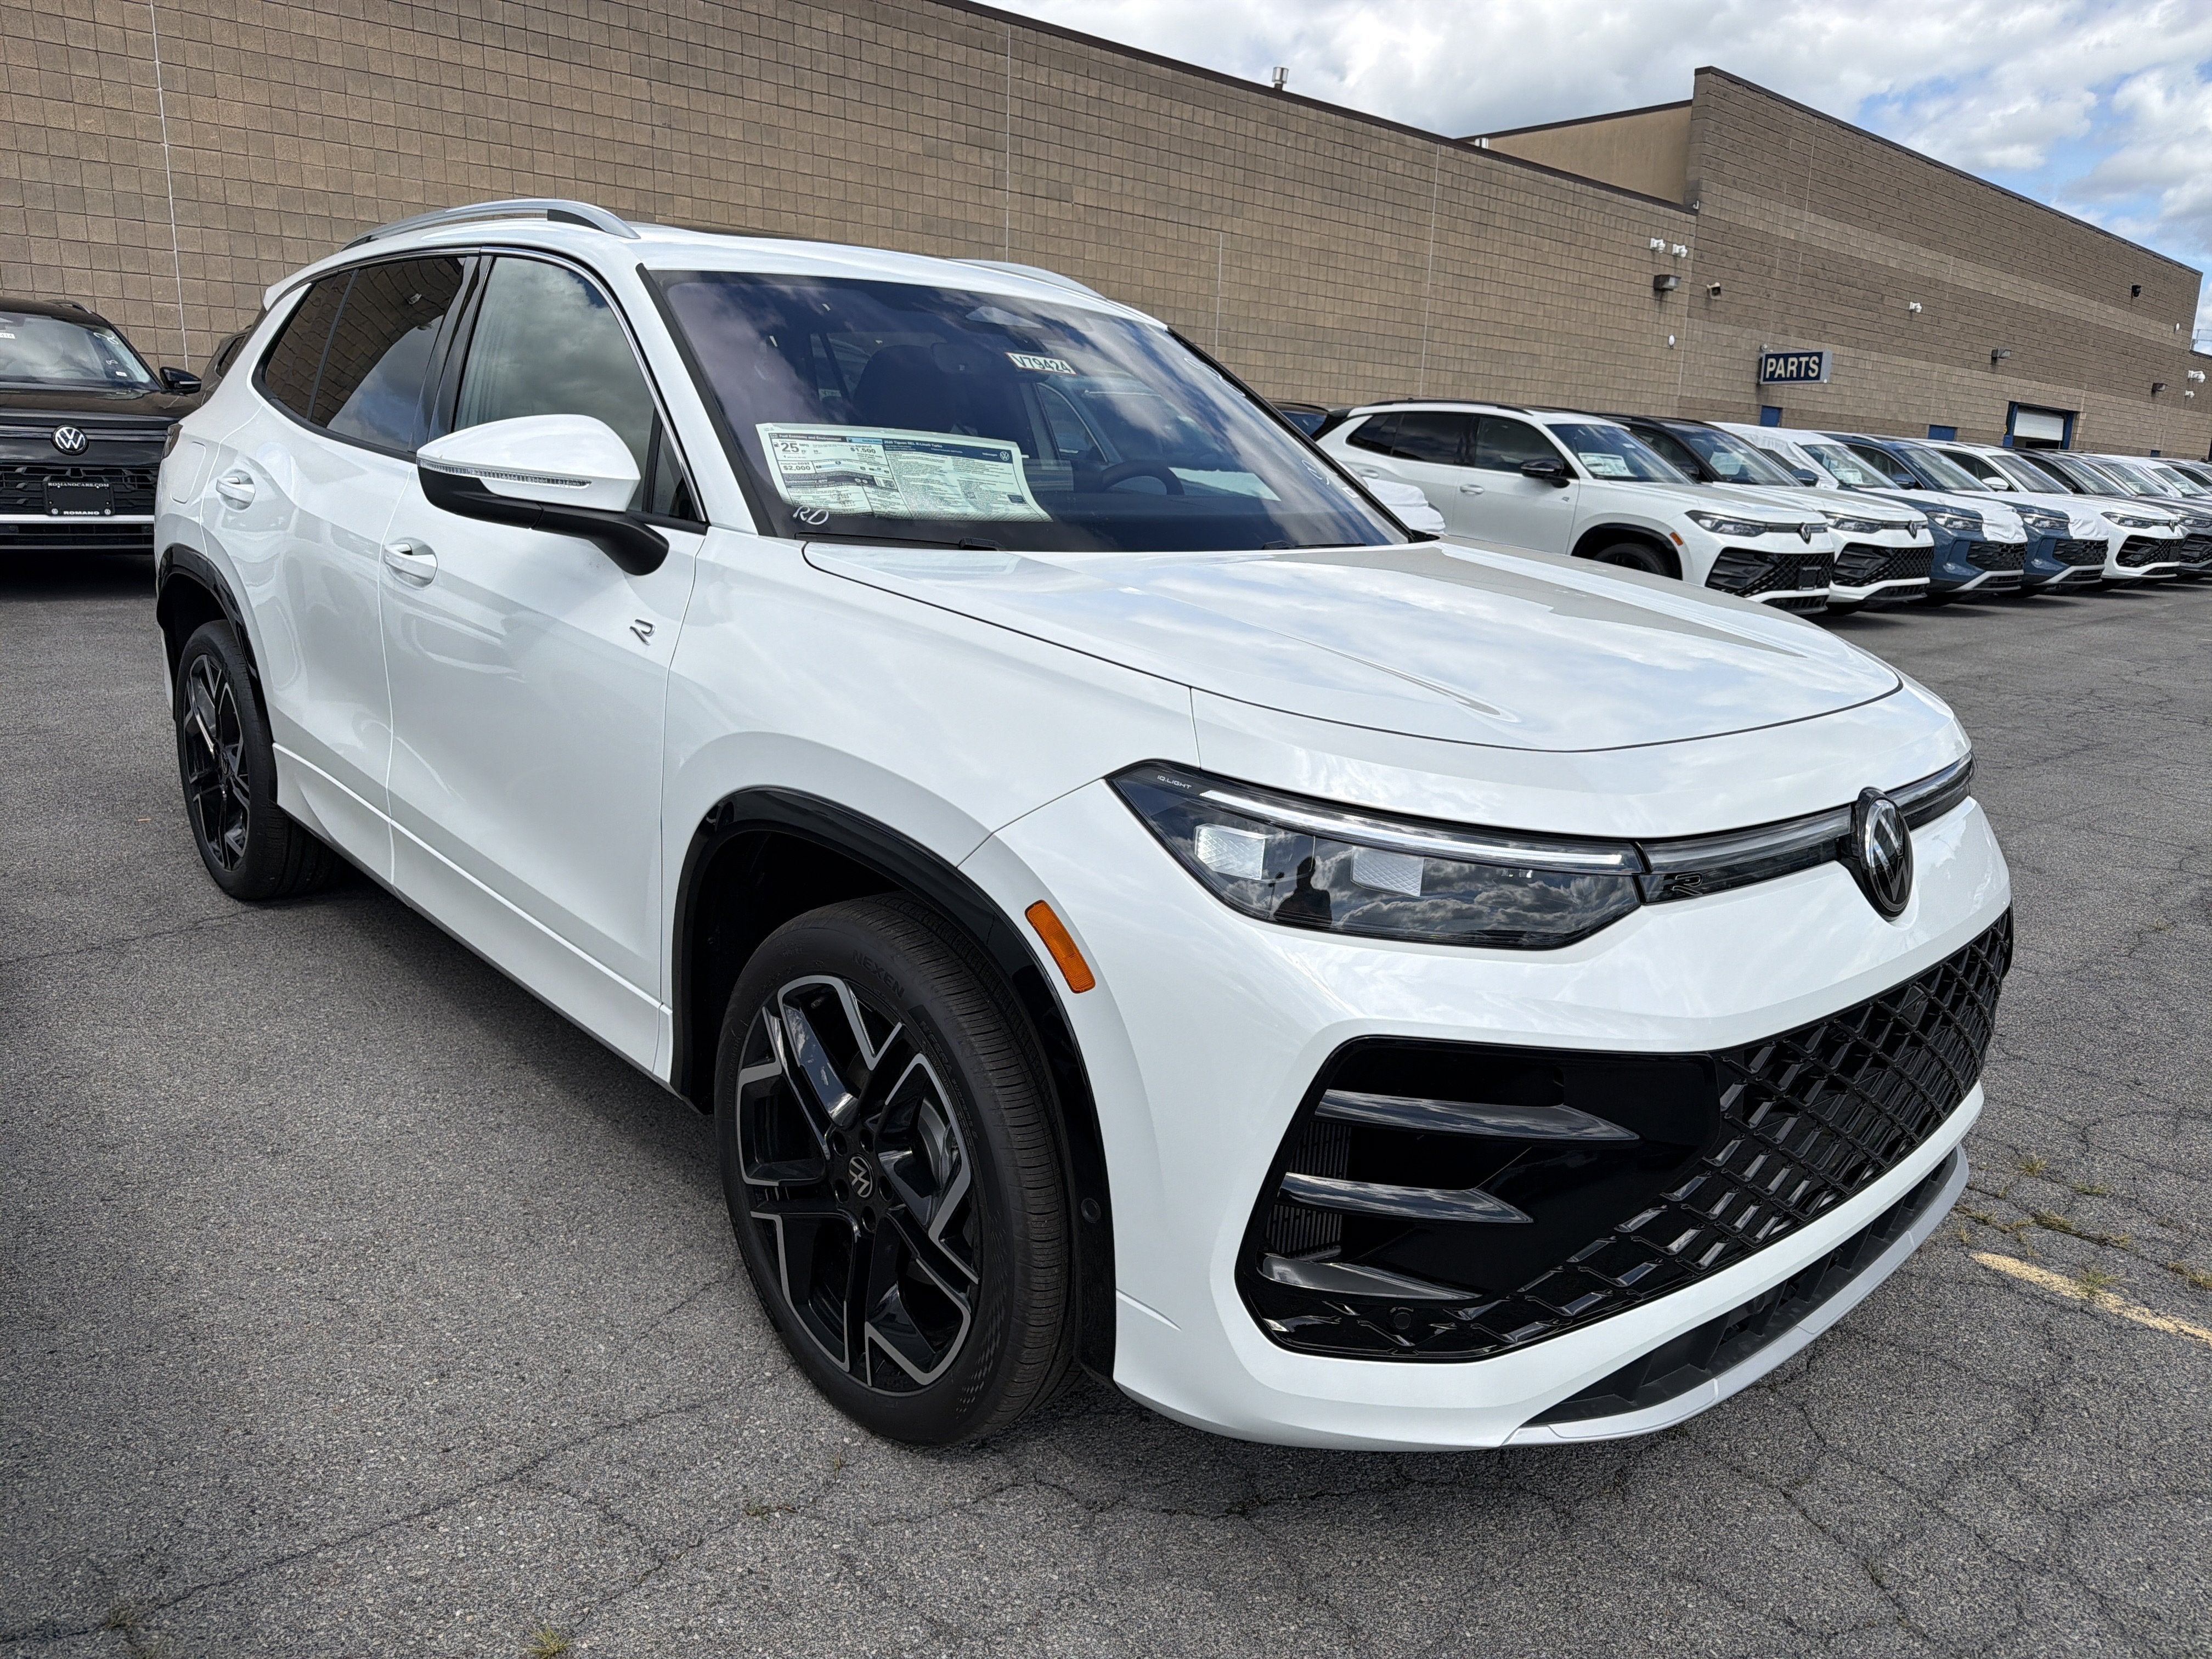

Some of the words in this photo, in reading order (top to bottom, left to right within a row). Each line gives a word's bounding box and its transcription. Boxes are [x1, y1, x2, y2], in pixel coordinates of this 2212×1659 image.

[1012, 354, 1071, 374] V79424
[1765, 356, 1819, 379] PARTS
[780, 442, 799, 453] 25
[1157, 775, 1192, 789] IQ.LIGHT
[851, 950, 905, 1000] NEXEN
